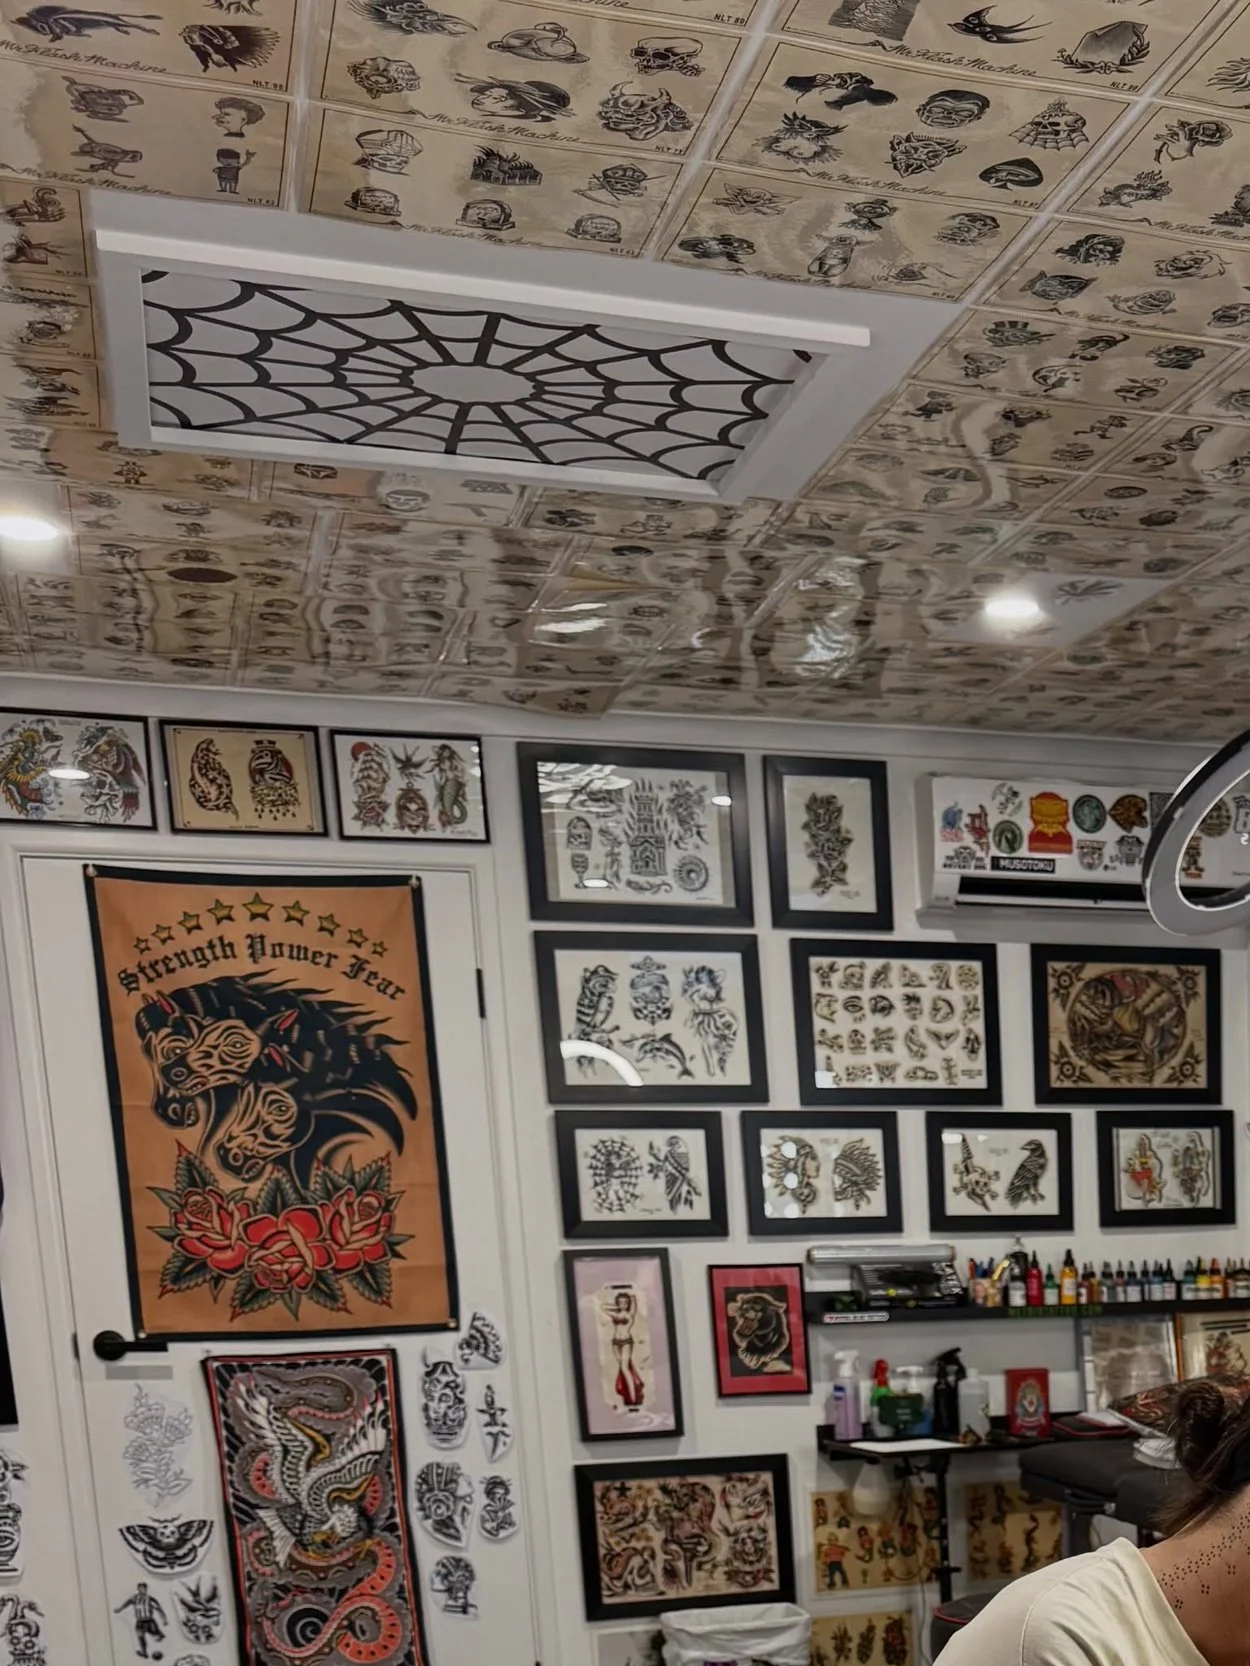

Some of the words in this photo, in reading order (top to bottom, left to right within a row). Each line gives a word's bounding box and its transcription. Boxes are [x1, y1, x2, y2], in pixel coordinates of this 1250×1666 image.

[117, 935, 237, 996] Strength
[246, 933, 339, 969] Power
[341, 954, 405, 1000] Fear
